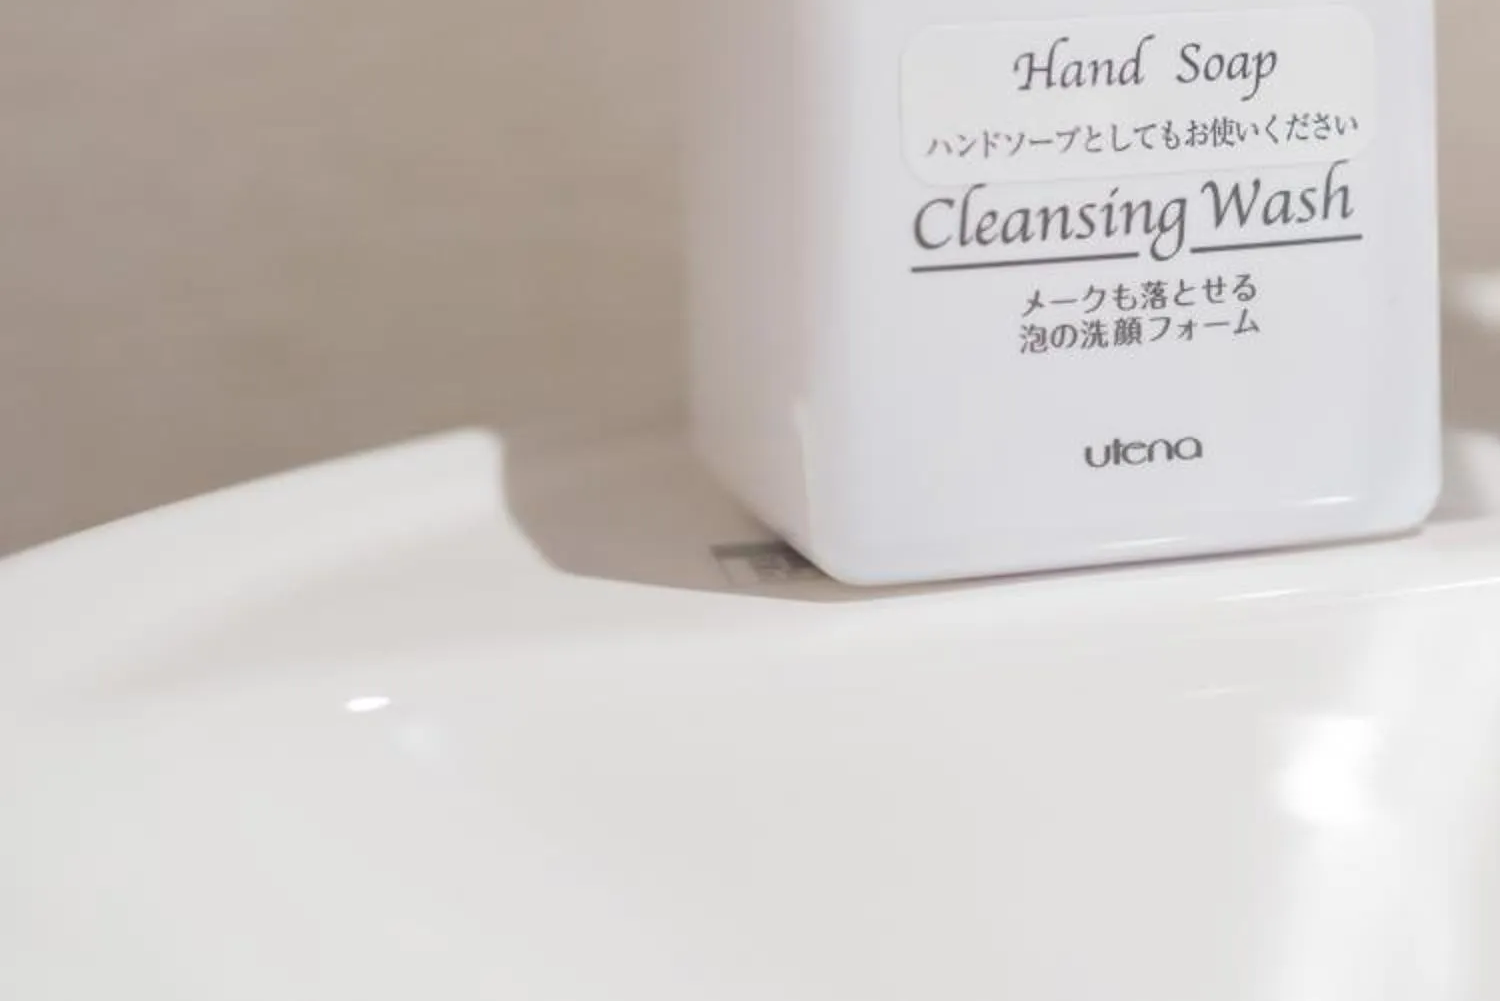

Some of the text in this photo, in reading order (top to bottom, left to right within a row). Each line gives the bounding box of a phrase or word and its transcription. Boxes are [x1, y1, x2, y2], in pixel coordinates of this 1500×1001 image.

[1013, 35, 1279, 101] Hand Soap
[926, 111, 1359, 159] ハンドソープとしてもお使いください
[913, 159, 1354, 262] Cleansing Wash
[1022, 274, 1257, 317] メークも落とせる
[1020, 308, 1260, 355] 泡の洗顔フォーム
[1084, 436, 1203, 468] utena
